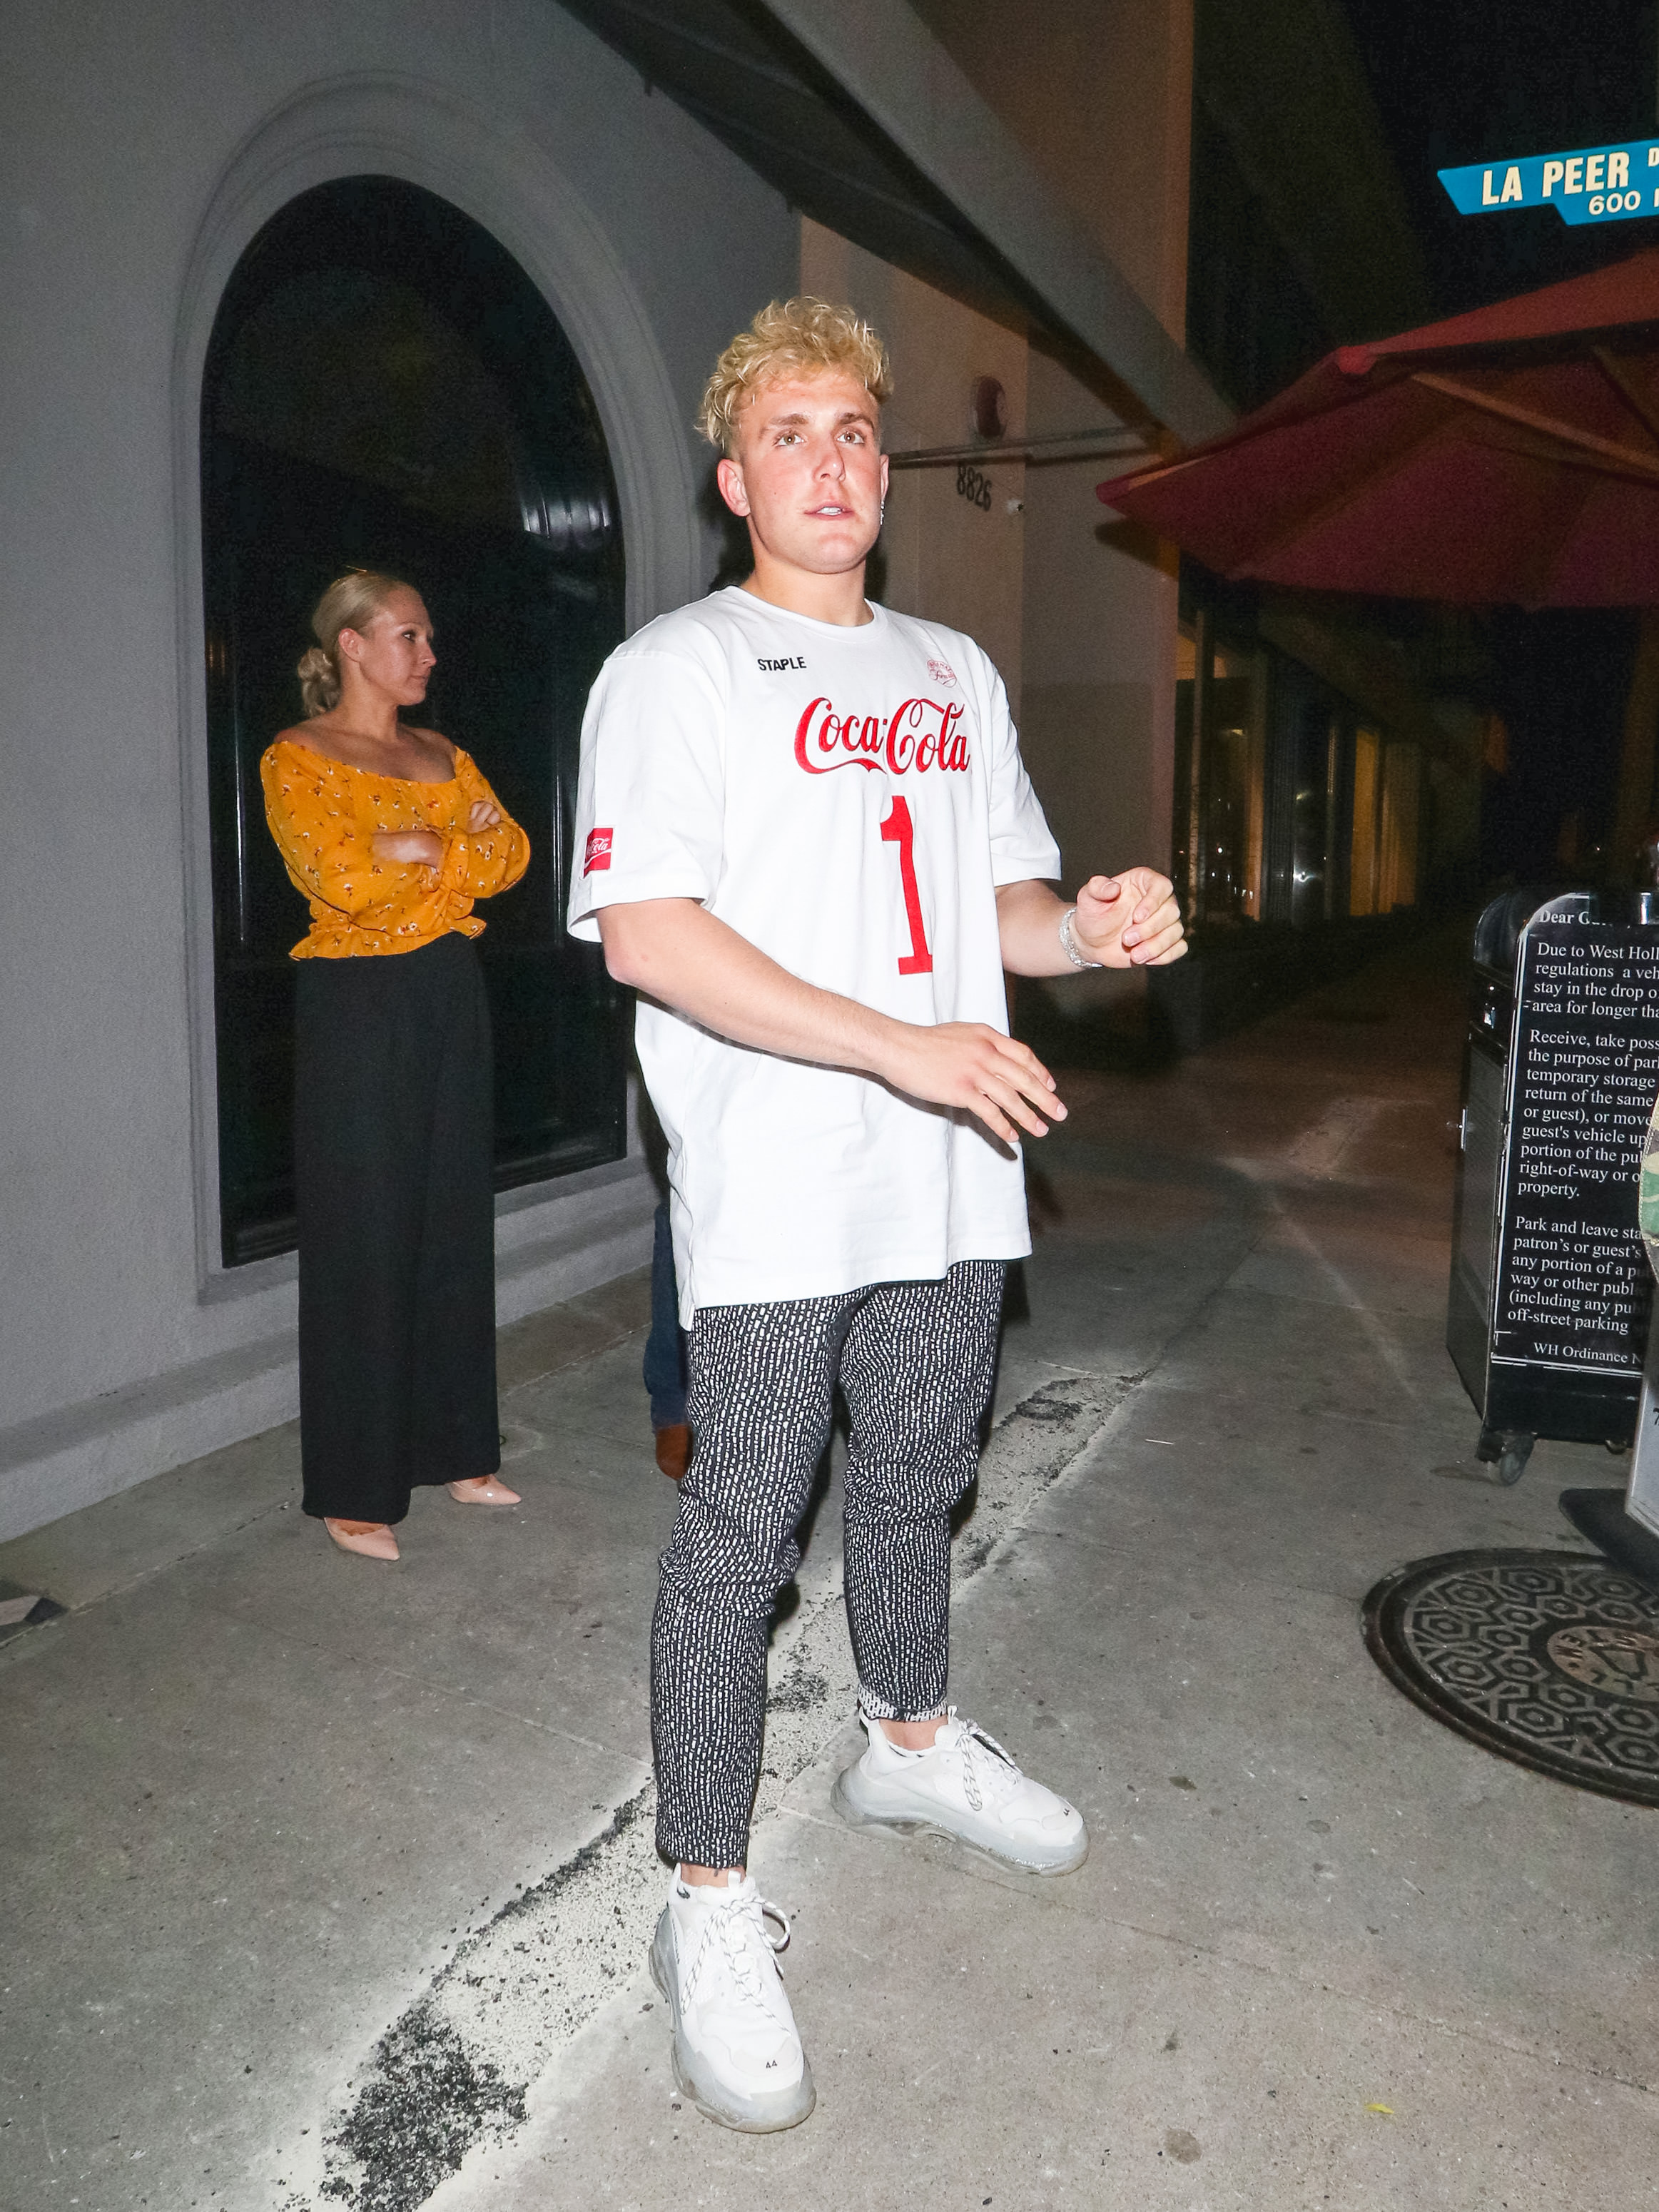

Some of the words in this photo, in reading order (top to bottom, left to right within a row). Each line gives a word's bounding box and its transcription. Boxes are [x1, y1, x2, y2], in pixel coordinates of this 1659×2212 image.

[1482, 166, 1523, 206] LA
[1542, 151, 1630, 198] PEER
[1588, 190, 1641, 215] 600
[957, 461, 992, 512] 8826
[757, 656, 807, 671] STAPLE
[880, 796, 933, 975] 1
[1539, 910, 1574, 925] Dear
[1538, 942, 1567, 956] Due
[1571, 945, 1584, 957] to
[1590, 944, 1624, 958] West
[1628, 946, 1659, 960] Holl
[1536, 963, 1614, 978] regulations
[1623, 968, 1630, 978] a
[1534, 982, 1562, 997] stay
[1567, 981, 1580, 995] in
[1586, 982, 1607, 996] the
[1611, 983, 1644, 1001] drop
[1532, 1001, 1561, 1013] area
[1567, 1000, 1588, 1014] for
[1592, 1001, 1638, 1020] longer
[1530, 1029, 1590, 1047] Receive,
[1595, 1034, 1625, 1047] take
[1528, 1048, 1550, 1062] the
[1553, 1052, 1610, 1067] purpose
[1615, 1054, 1633, 1067] of
[1527, 1069, 1599, 1087] temporary
[1603, 1074, 1655, 1090] storage
[1525, 1088, 1567, 1101] return
[1571, 1090, 1589, 1102] of
[1591, 1090, 1613, 1104] the
[1616, 1095, 1654, 1107] same
[1523, 1107, 1539, 1118] or
[1542, 1107, 1589, 1124] guest),
[1594, 1112, 1610, 1122] or
[1522, 1126, 1569, 1139] guest's
[1574, 1128, 1625, 1143] vehicle
[1521, 1143, 1571, 1158] portion
[1576, 1147, 1593, 1160] of
[1595, 1148, 1617, 1161] the
[1519, 1160, 1608, 1183] right-of-way
[1613, 1171, 1628, 1181] or
[1517, 1182, 1580, 1199] property.
[1516, 1216, 1547, 1231] Park
[1551, 1221, 1576, 1234] and
[1581, 1222, 1618, 1237] leave
[1513, 1237, 1570, 1252] patron’s
[1573, 1244, 1590, 1253] or
[1512, 1256, 1538, 1270] any
[1541, 1258, 1591, 1272] portion
[1596, 1262, 1614, 1274] of
[1615, 1267, 1623, 1276] a
[1511, 1274, 1540, 1289] way
[1543, 1278, 1559, 1288] or
[1563, 1277, 1599, 1292] other
[1509, 1289, 1581, 1312] (including
[1585, 1300, 1610, 1314] any
[1508, 1308, 1571, 1326] off-street
[1574, 1316, 1629, 1335] parking
[1534, 1342, 1559, 1356] WH
[1563, 1346, 1628, 1363] Ordinance
